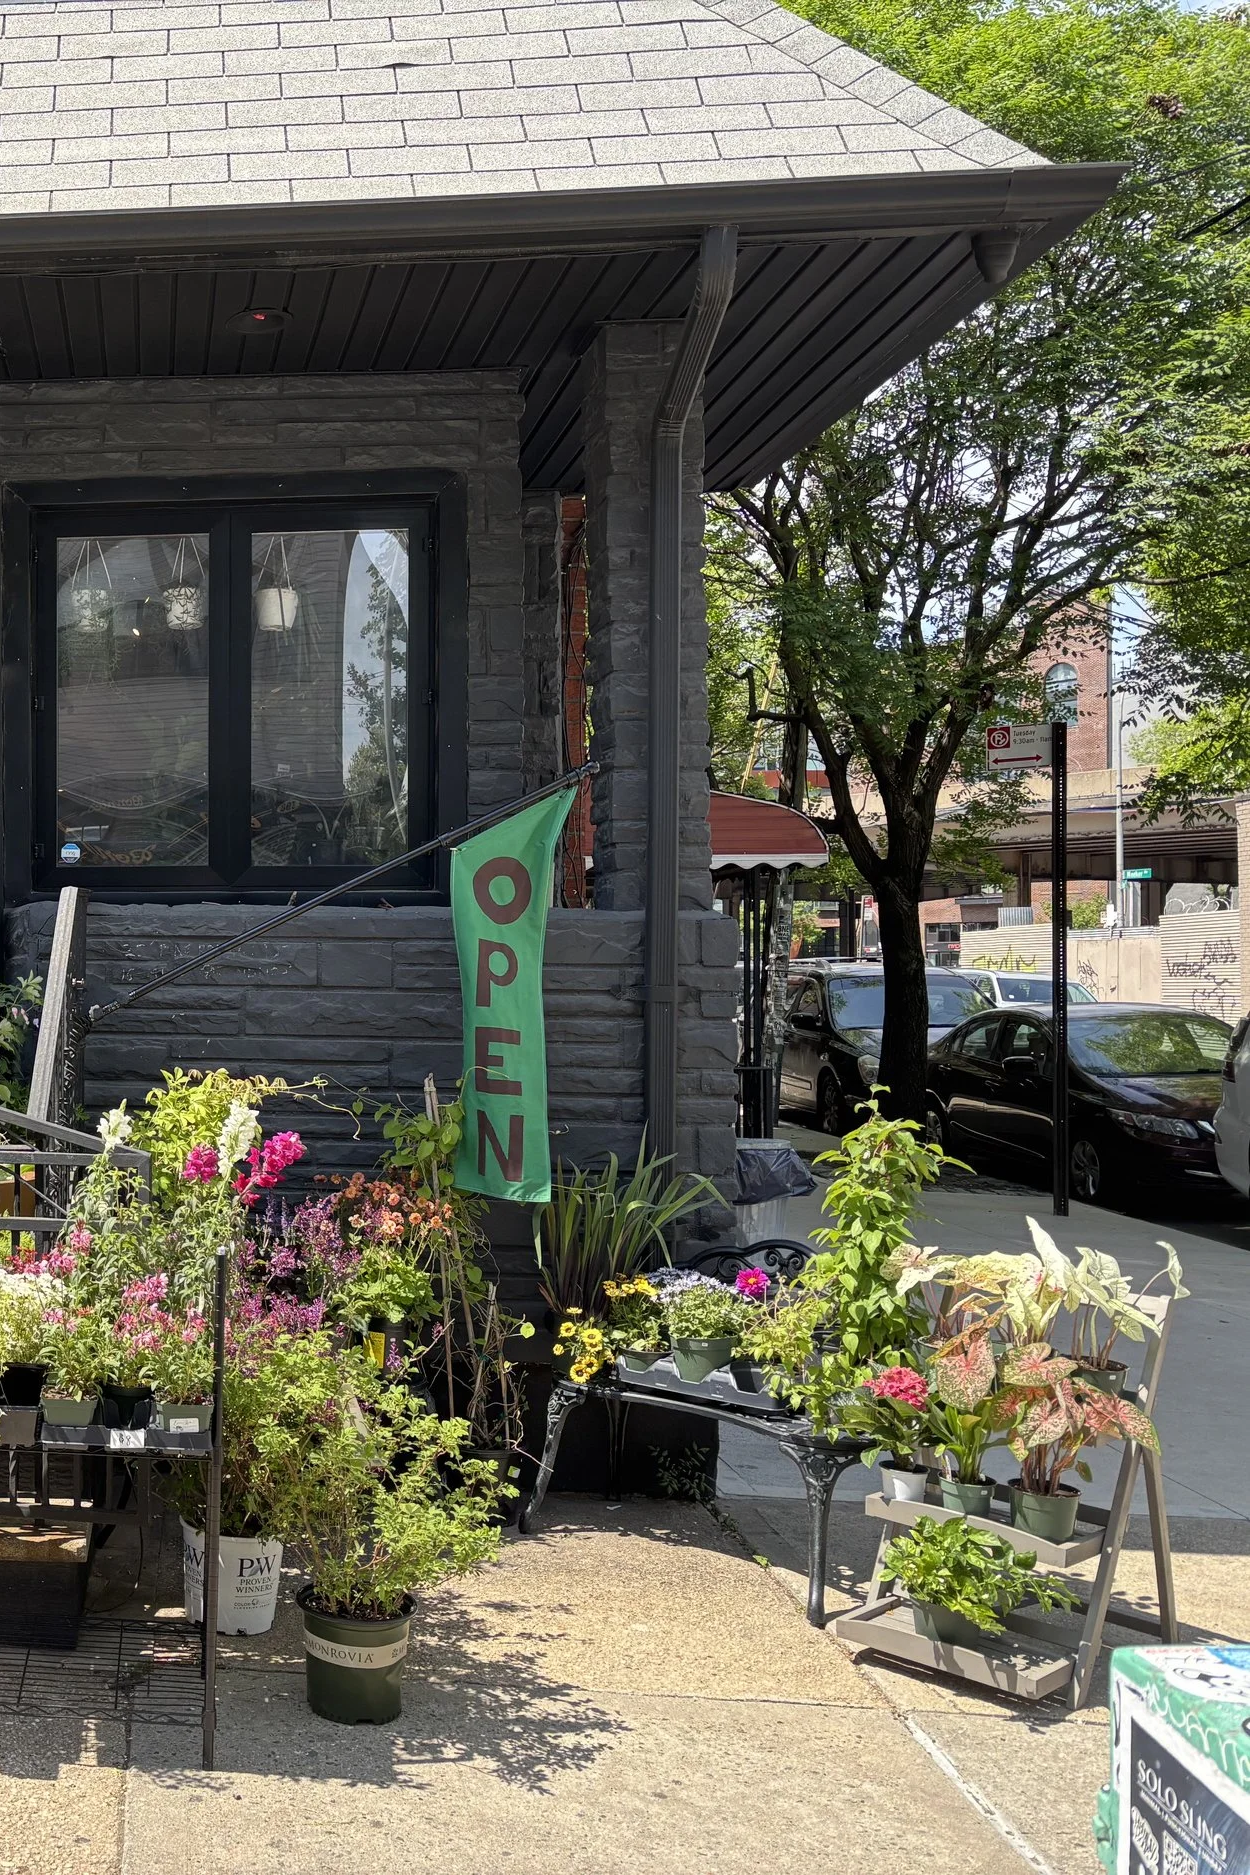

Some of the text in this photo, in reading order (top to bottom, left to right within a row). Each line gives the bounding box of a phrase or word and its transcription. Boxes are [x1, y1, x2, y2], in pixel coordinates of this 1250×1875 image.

[472, 856, 533, 1183] OPEN
[237, 1554, 276, 1577] PW
[235, 1583, 274, 1593] WINNERS
[240, 1576, 271, 1585] PROVEN
[1137, 1759, 1178, 1812] SOLO
[1179, 1799, 1227, 1861] SLING
